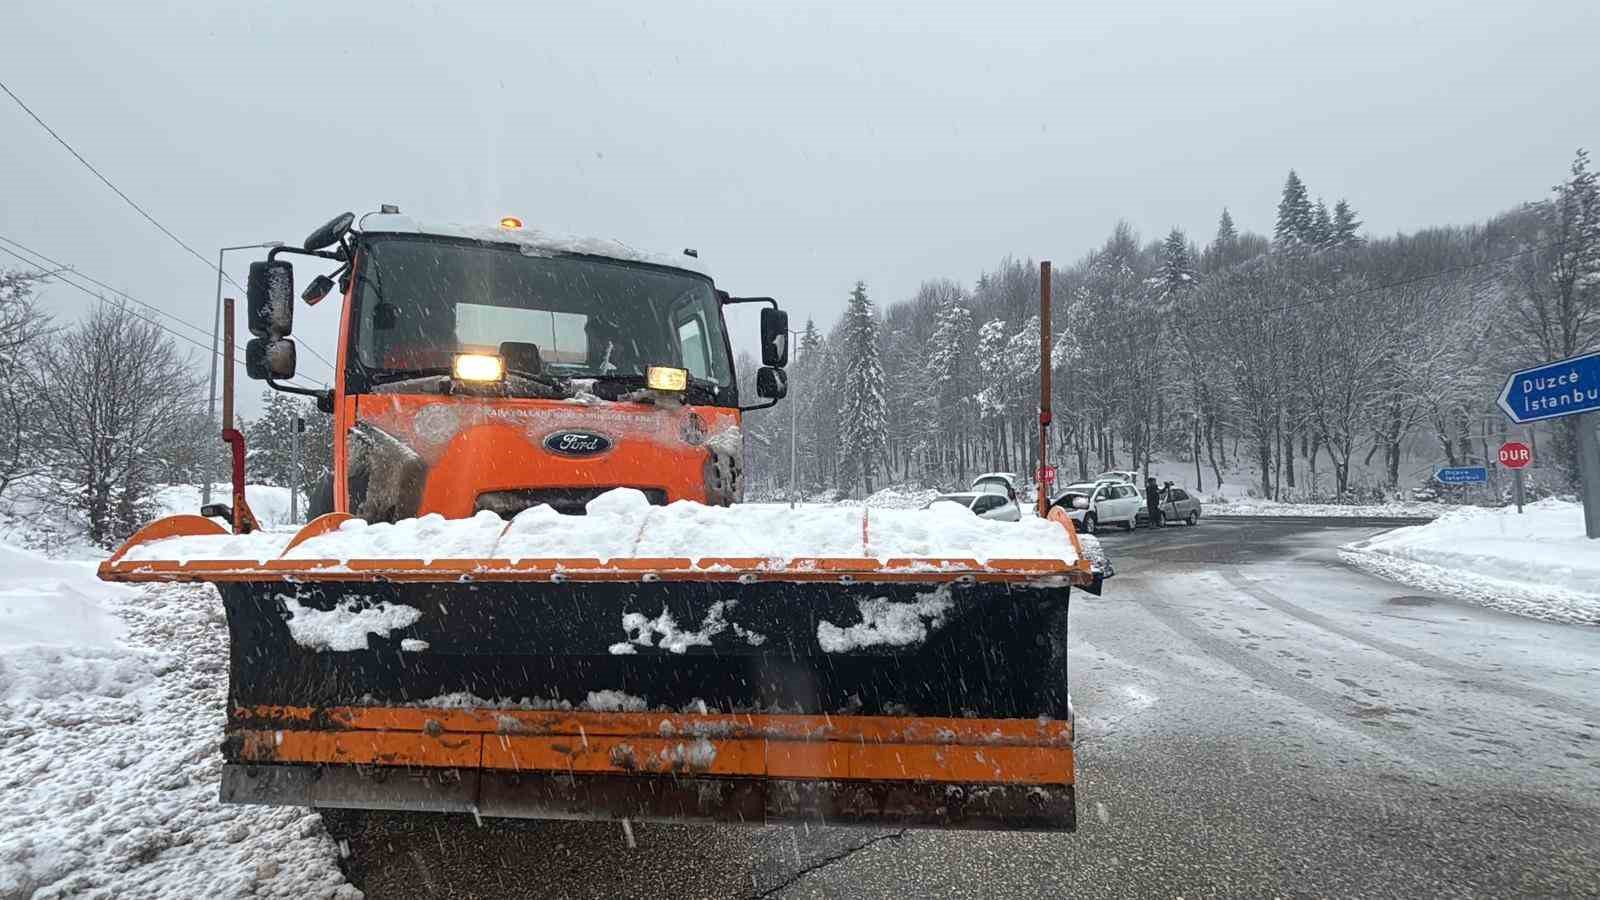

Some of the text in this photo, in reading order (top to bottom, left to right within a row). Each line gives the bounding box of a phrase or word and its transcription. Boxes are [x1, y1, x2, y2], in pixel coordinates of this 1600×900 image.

[1524, 388, 1600, 412] İstanbu
[559, 433, 598, 450] Ford
[1500, 449, 1529, 461] DUR
